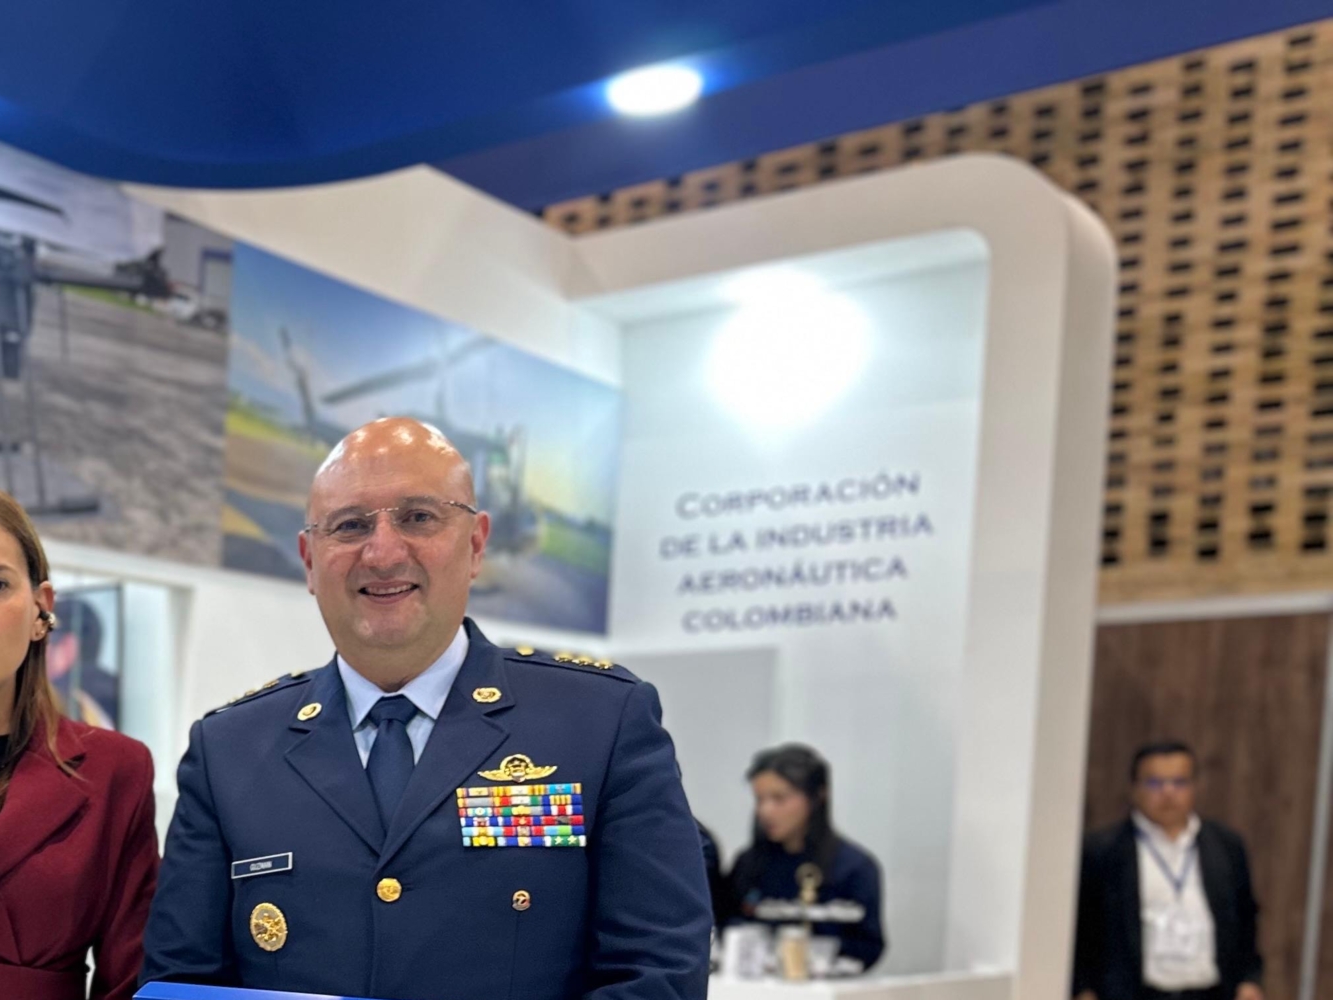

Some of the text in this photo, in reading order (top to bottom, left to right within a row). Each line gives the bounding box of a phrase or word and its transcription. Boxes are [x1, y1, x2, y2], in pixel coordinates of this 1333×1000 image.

[675, 468, 921, 520] CORPORACIÓN
[659, 513, 933, 560] DE LA INDUSTRIA
[678, 556, 908, 594] AERONÁUTICA
[681, 597, 897, 634] COLOMBIANA
